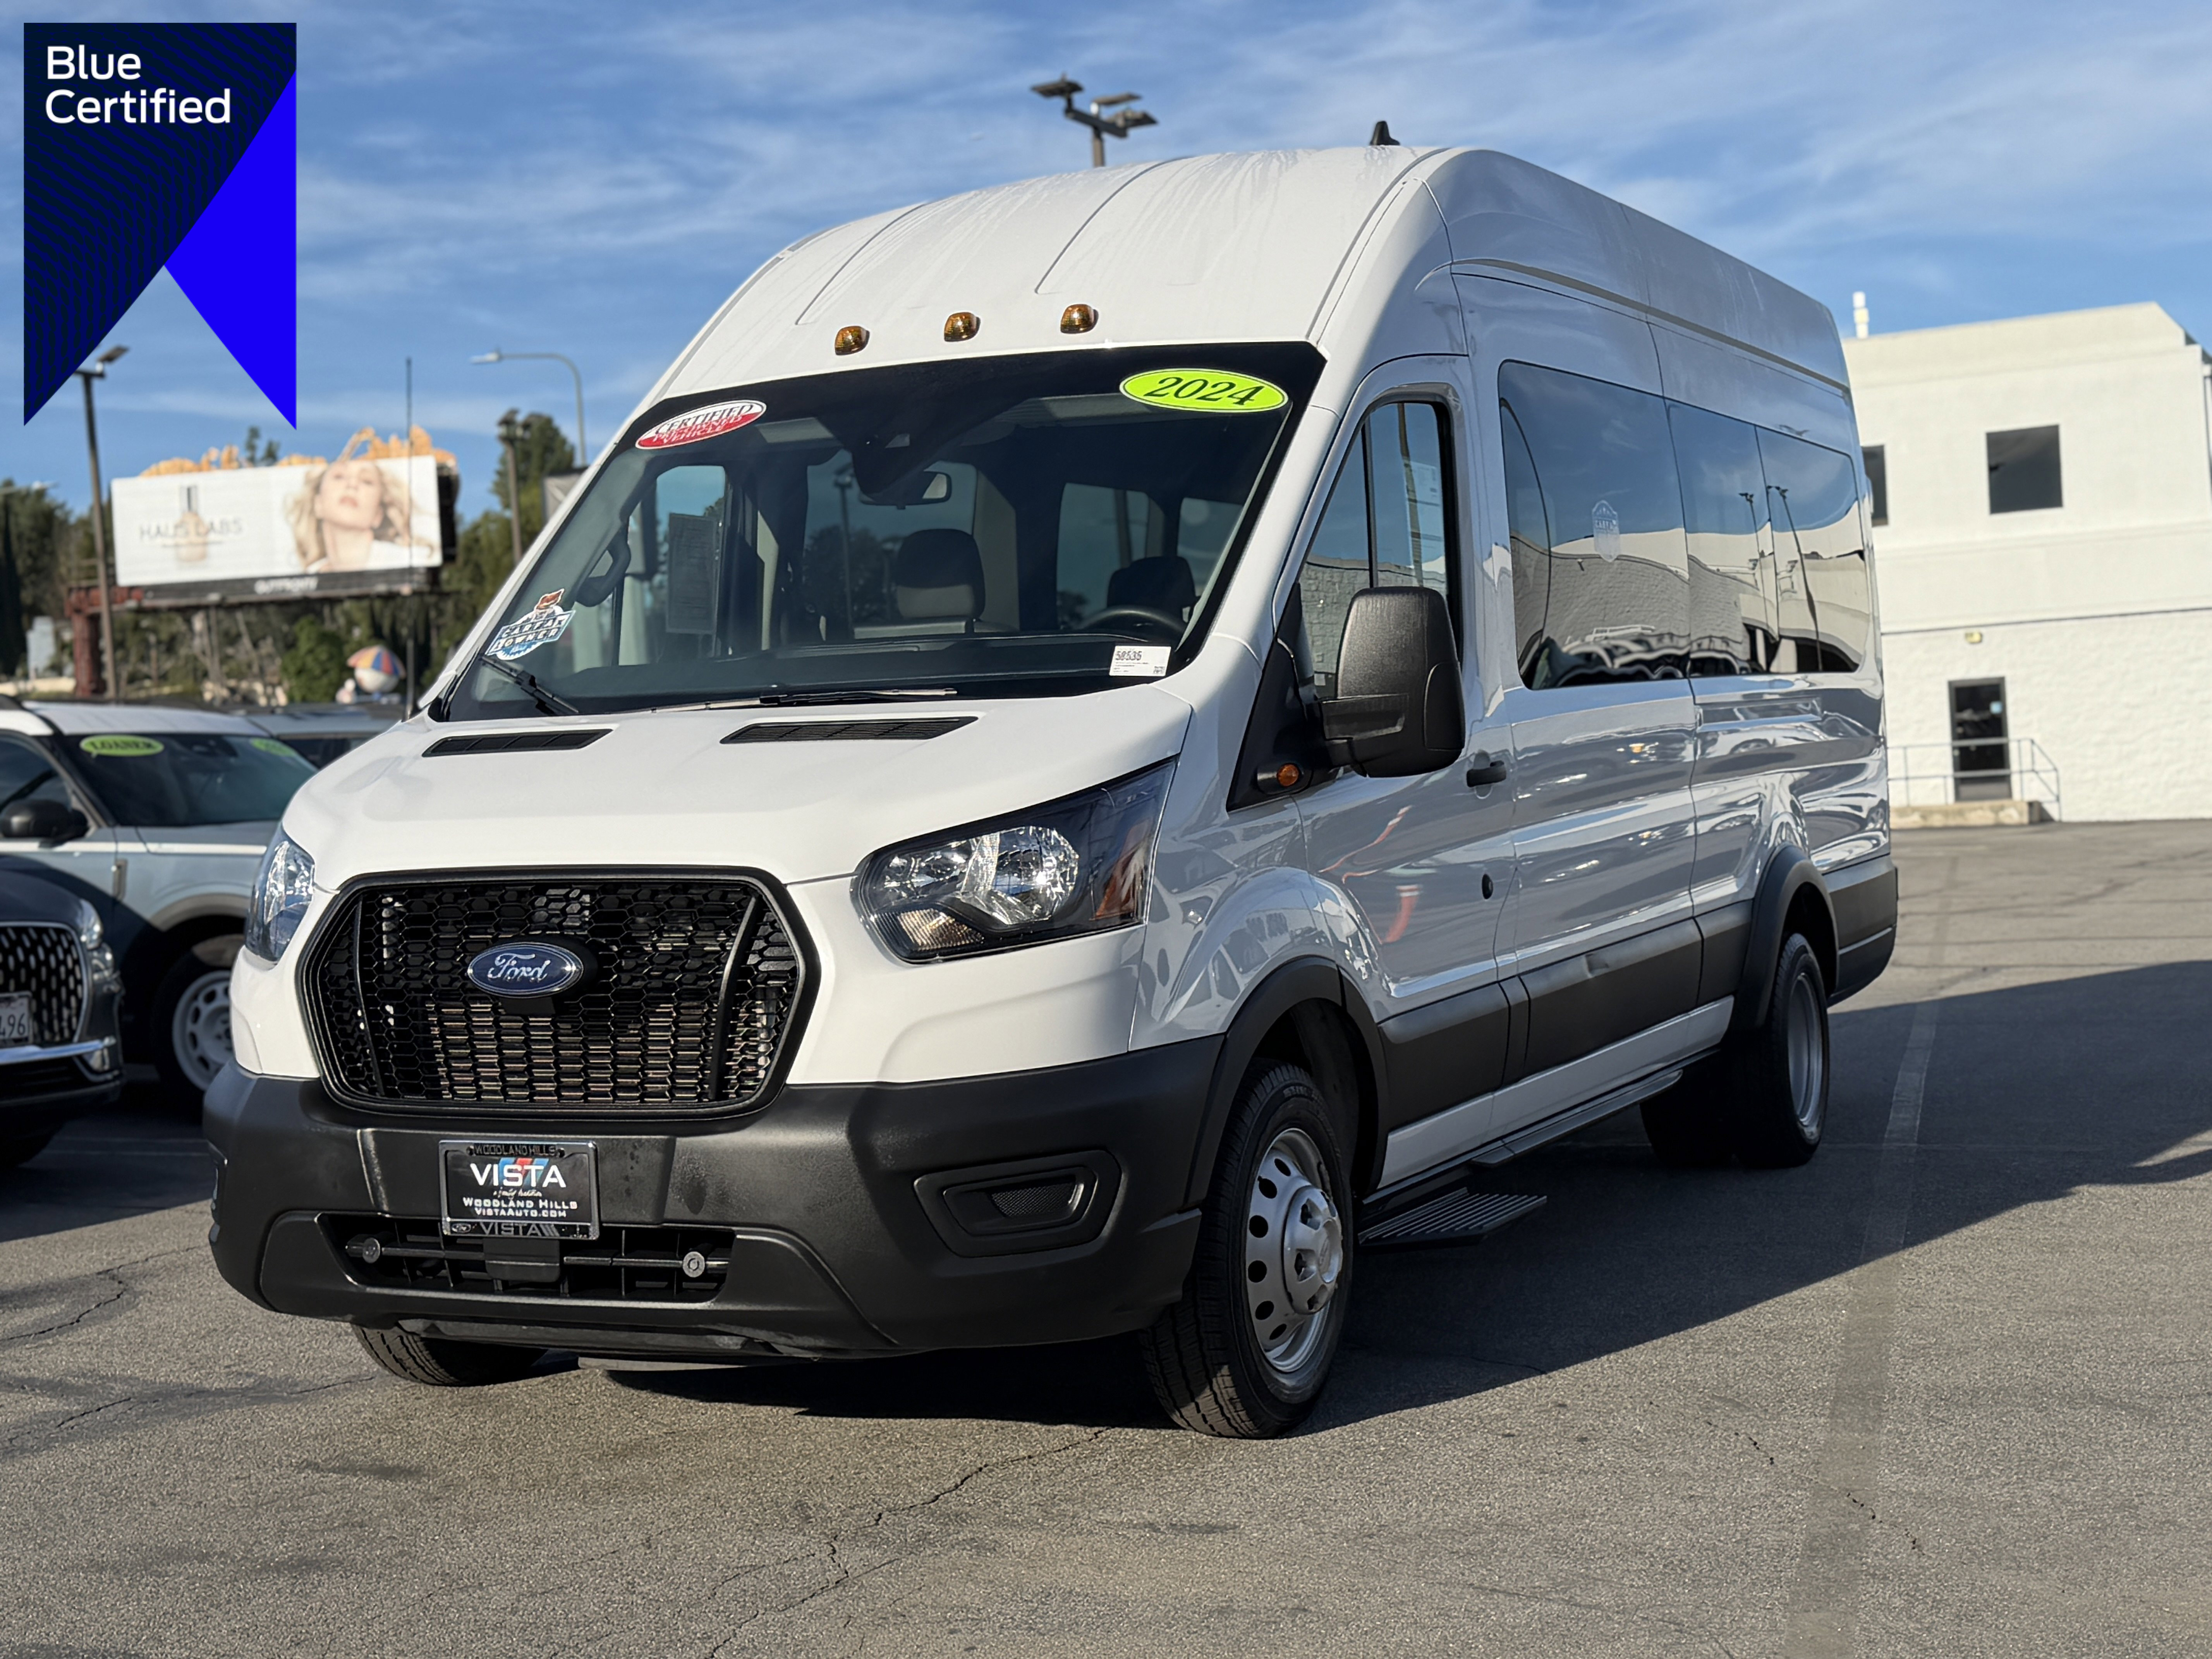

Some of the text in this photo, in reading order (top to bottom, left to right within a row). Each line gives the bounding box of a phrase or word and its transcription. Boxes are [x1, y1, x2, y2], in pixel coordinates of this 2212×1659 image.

[1143, 377, 1265, 405] 2024
[654, 404, 754, 434] CERTIFIED
[488, 953, 551, 981] Ford
[470, 1163, 567, 1188] VISTA
[479, 1222, 542, 1237] VISTA
